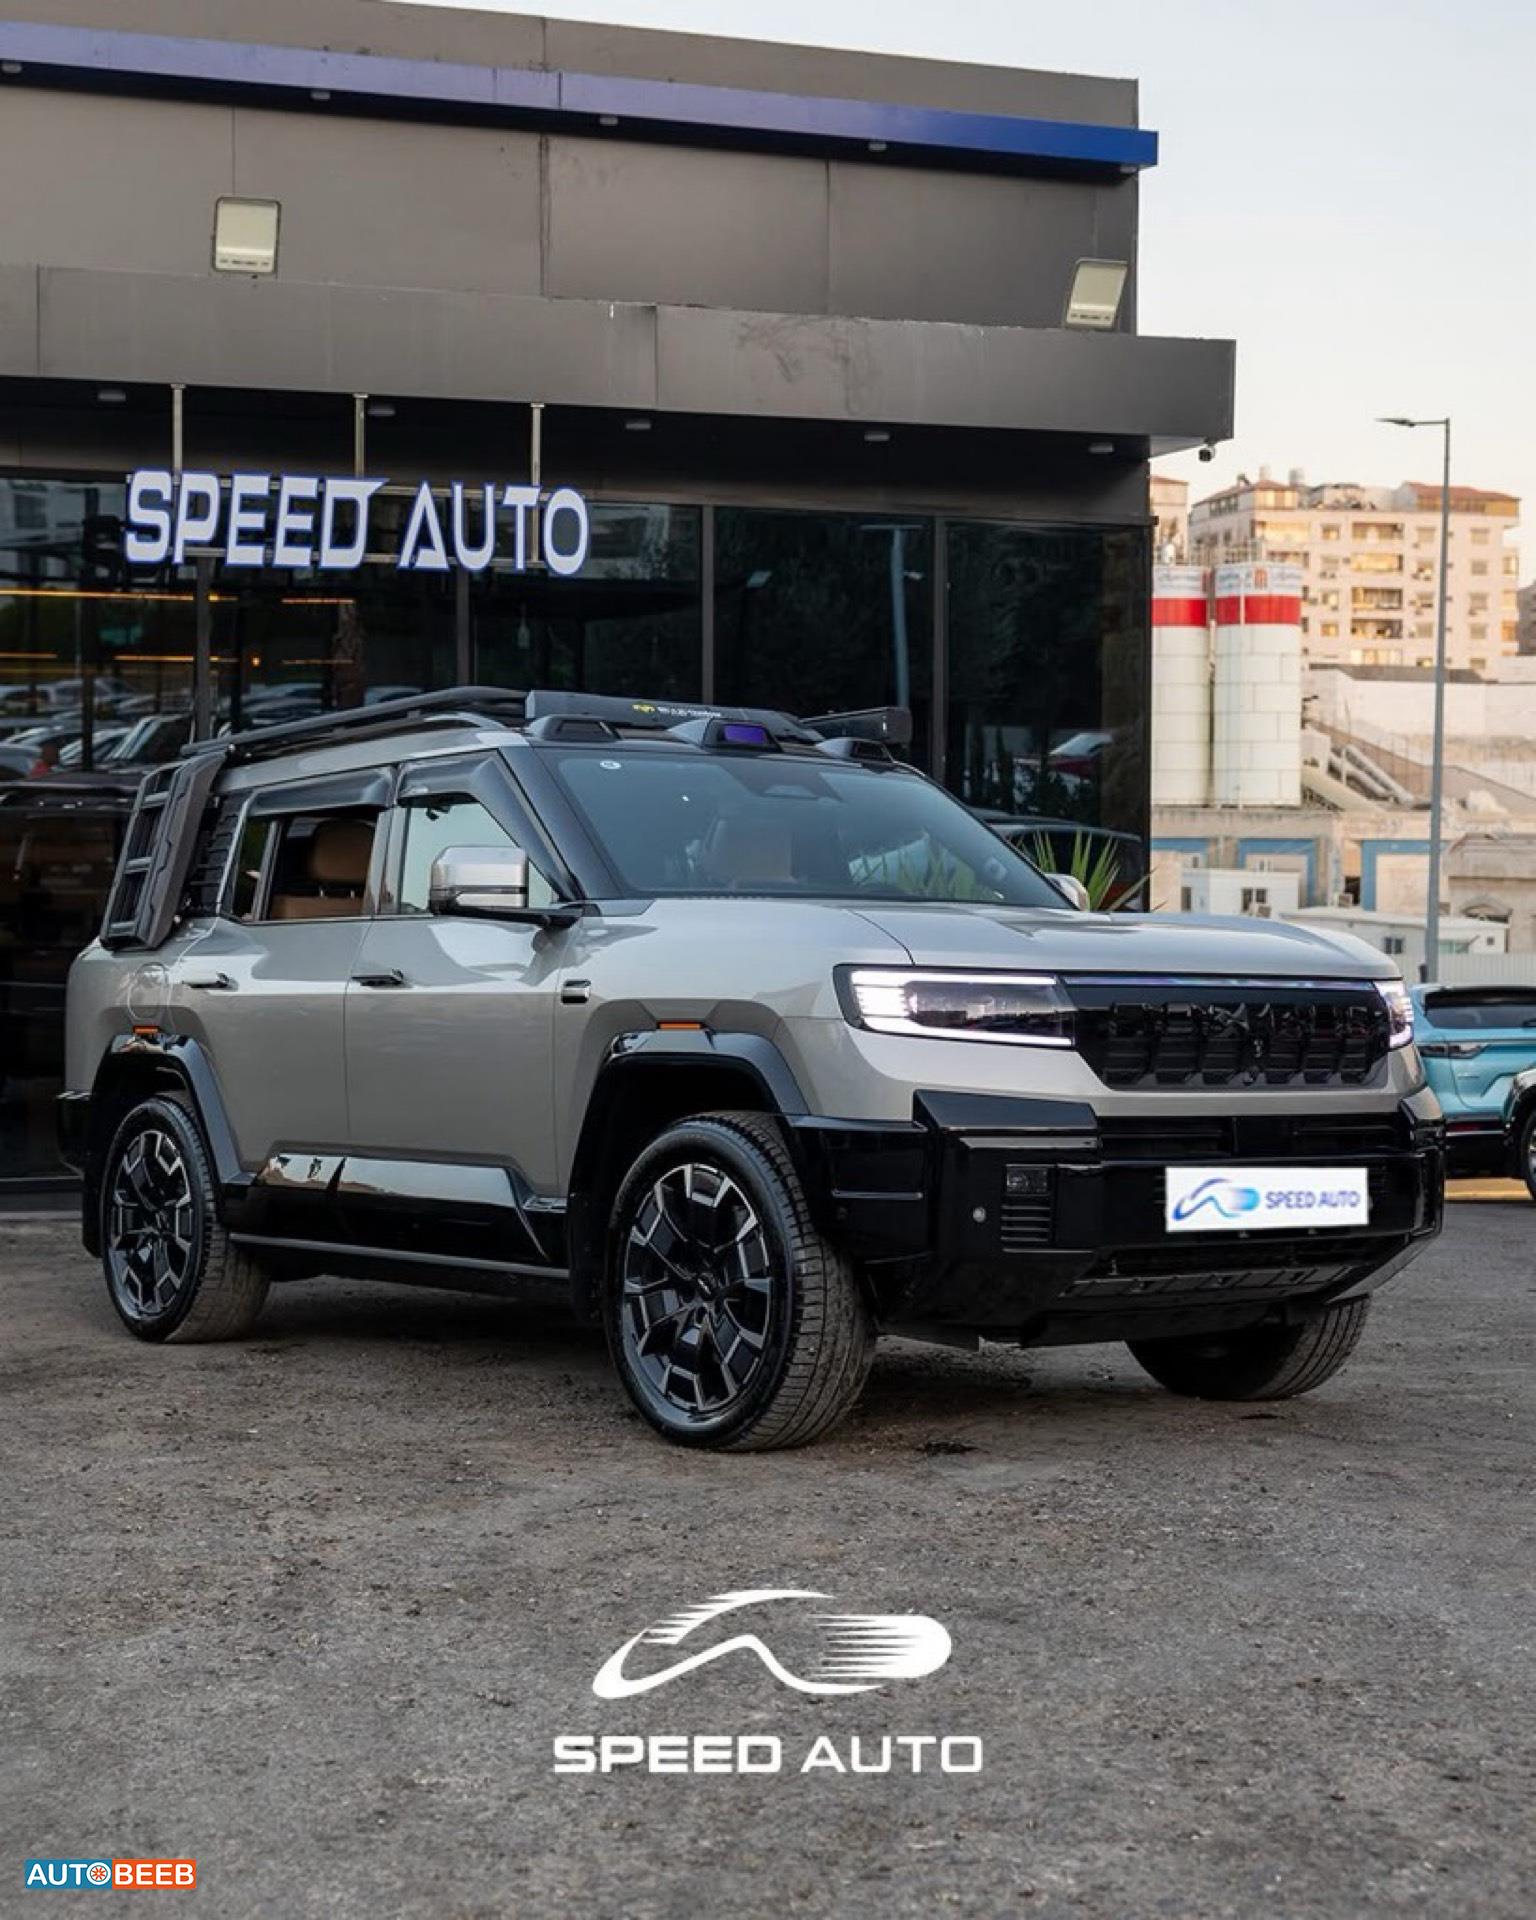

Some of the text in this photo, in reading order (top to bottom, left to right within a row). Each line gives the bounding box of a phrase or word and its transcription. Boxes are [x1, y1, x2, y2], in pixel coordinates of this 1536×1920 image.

[125, 470, 590, 576] SPEED AUTO
[1265, 1189, 1361, 1209] SPEED AUTO
